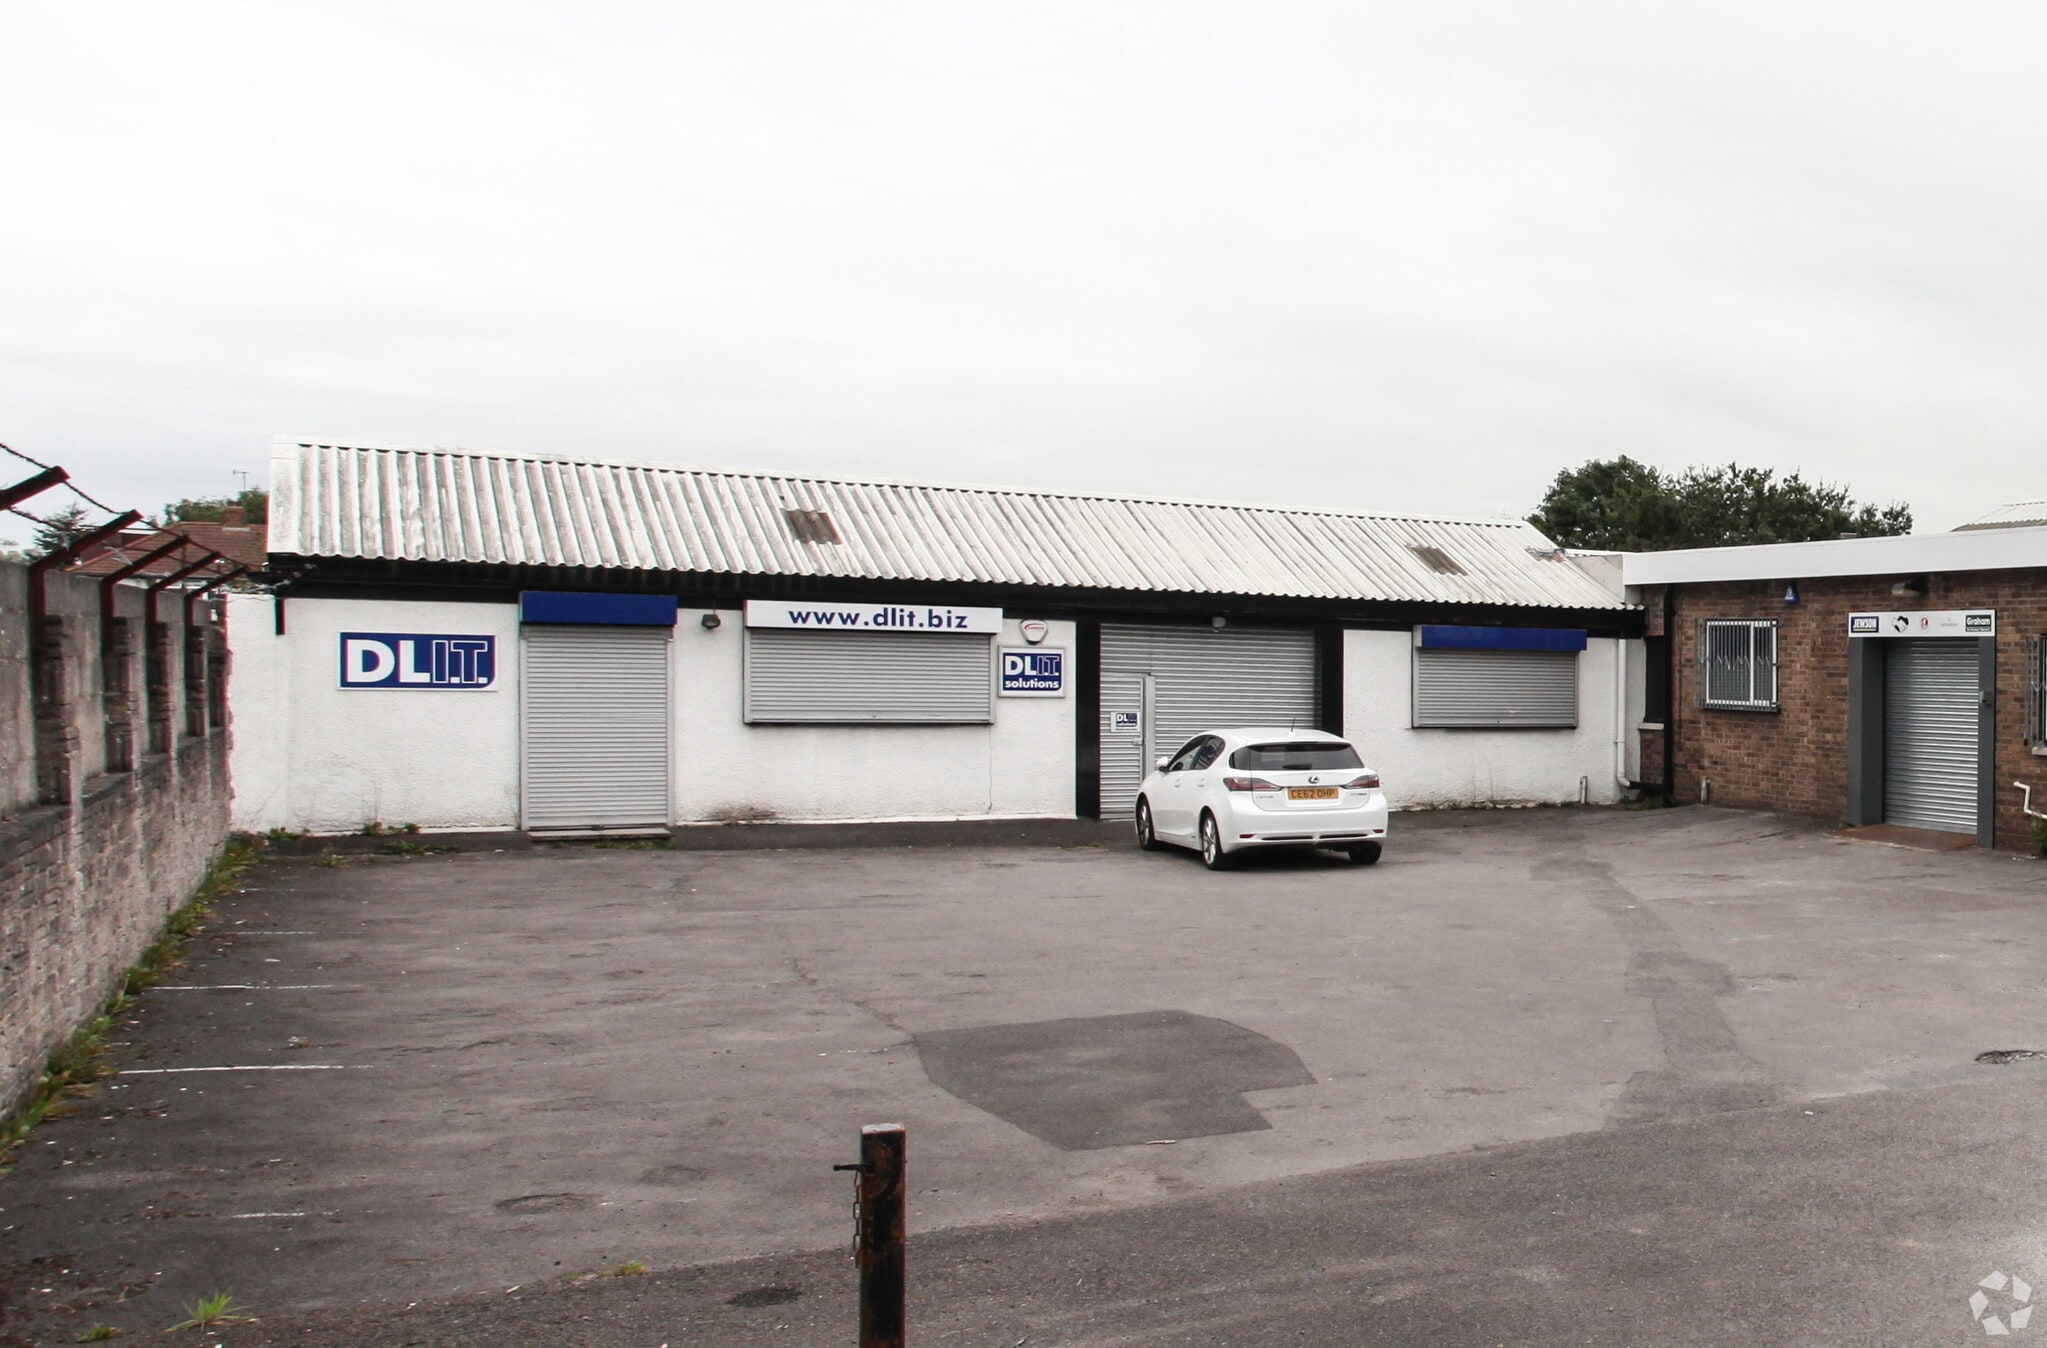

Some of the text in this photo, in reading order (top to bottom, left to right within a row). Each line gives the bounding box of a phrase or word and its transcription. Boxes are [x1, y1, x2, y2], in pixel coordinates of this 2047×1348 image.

[788, 607, 968, 629] www.dlit.biz
[1005, 678, 1059, 689] solutions
[1291, 788, 1335, 799] CE62 OHP
